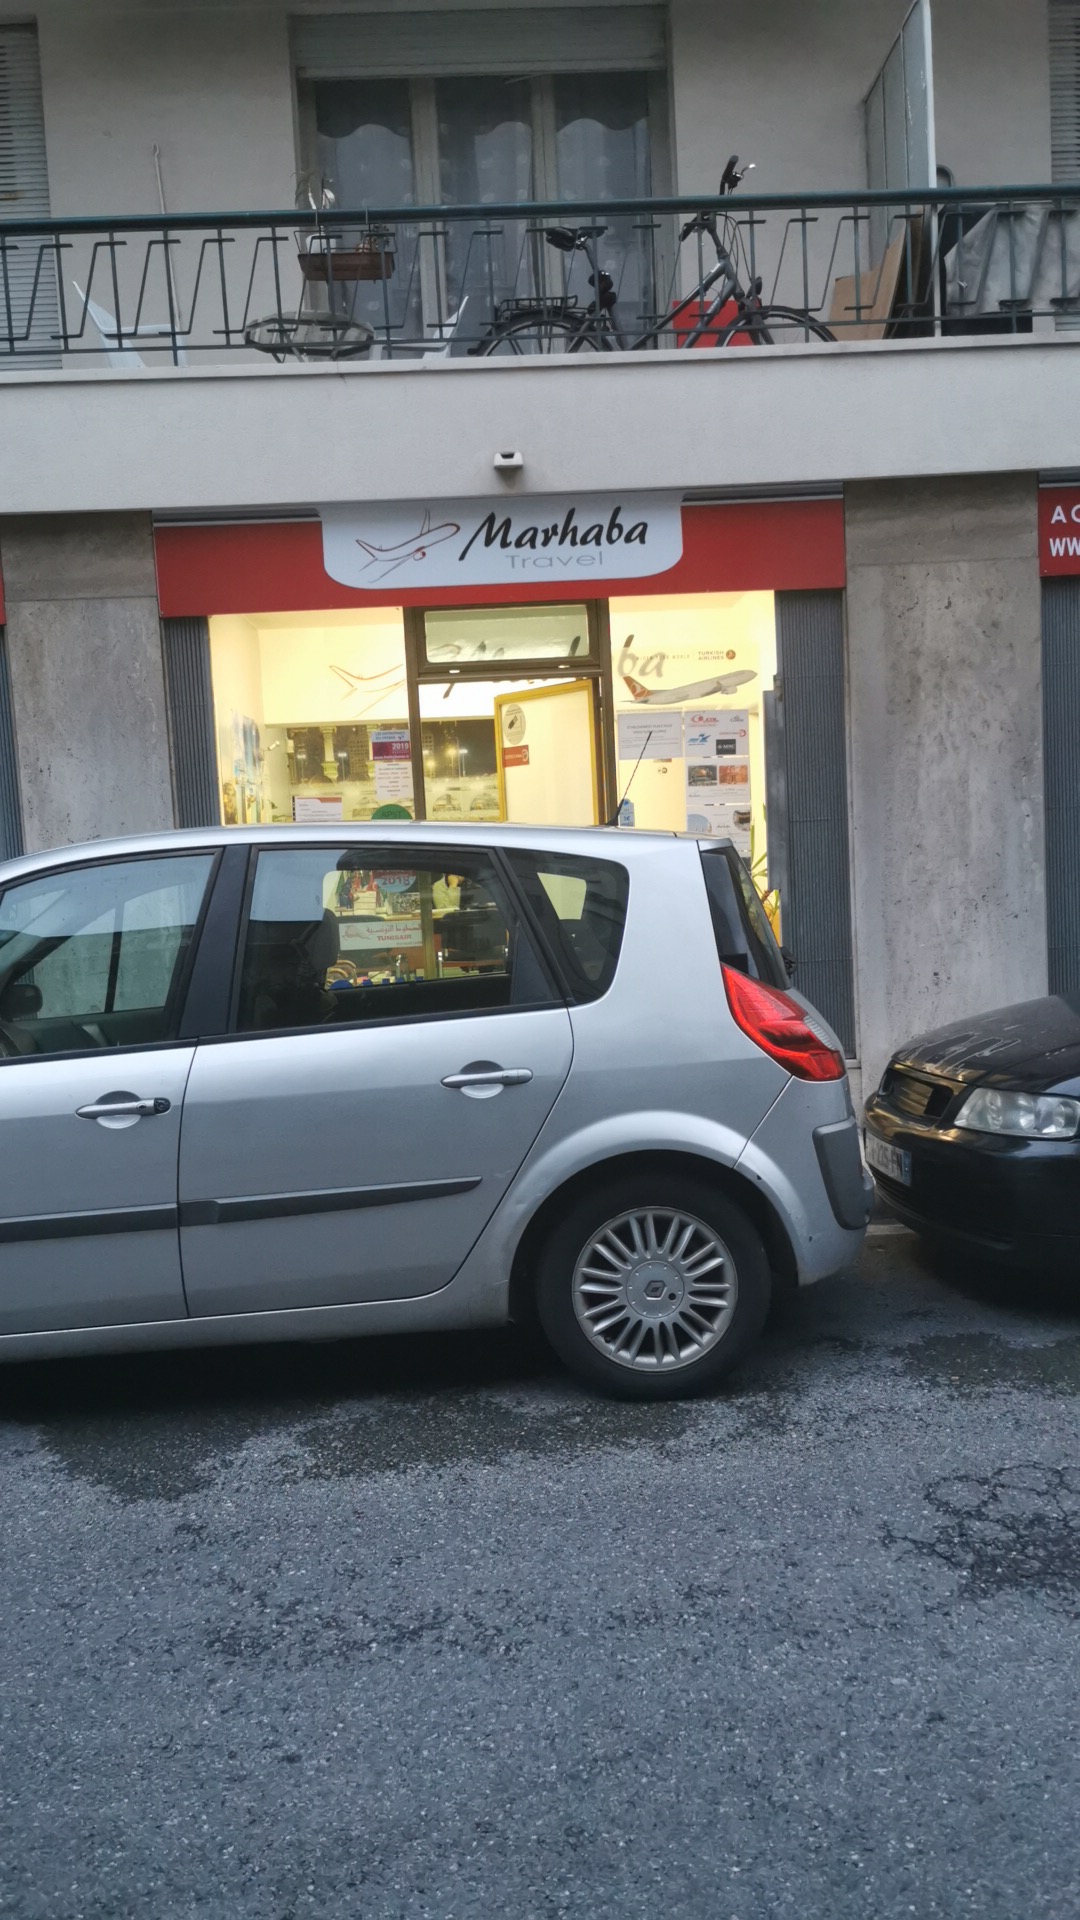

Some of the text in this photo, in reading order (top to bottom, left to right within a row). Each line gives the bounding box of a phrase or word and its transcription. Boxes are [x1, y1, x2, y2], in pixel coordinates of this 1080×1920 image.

[458, 506, 649, 562] Marhaba
[505, 551, 603, 569] Travel
[381, 876, 410, 886] 2018
[376, 934, 412, 942] TUNISAIR
